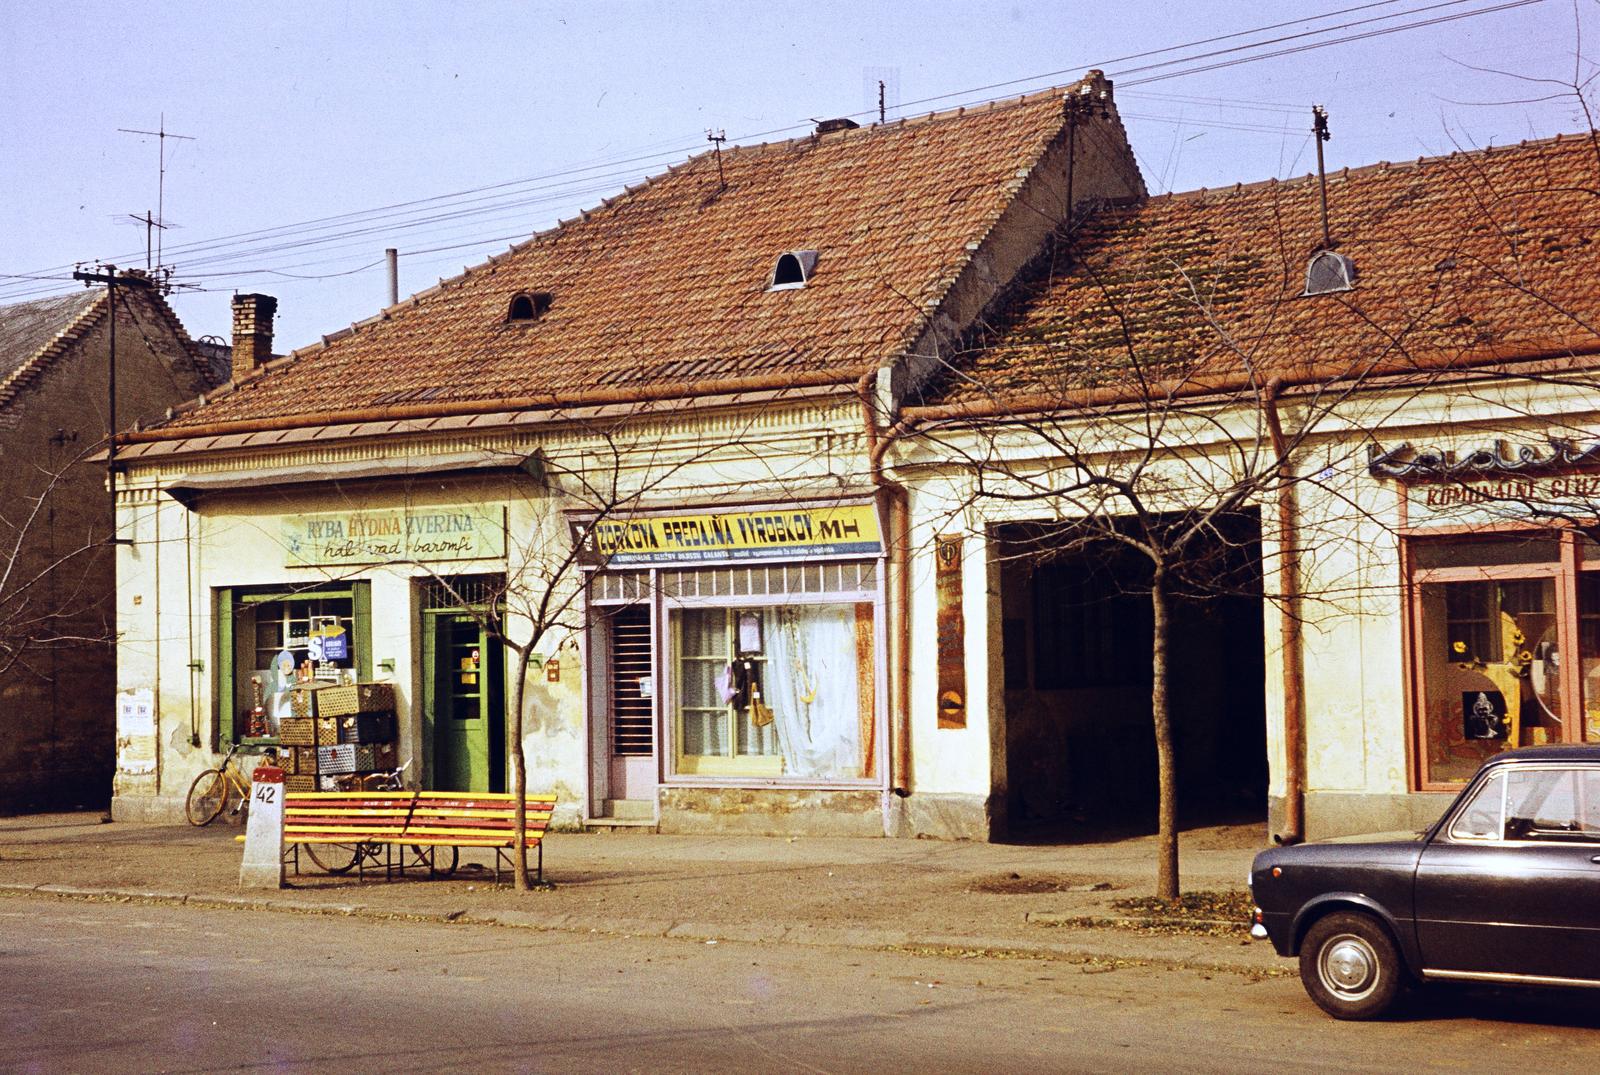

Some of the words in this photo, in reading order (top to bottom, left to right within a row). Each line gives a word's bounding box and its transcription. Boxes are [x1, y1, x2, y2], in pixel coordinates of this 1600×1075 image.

[308, 520, 344, 538] RYBA
[349, 516, 401, 537] HYDINA
[663, 515, 735, 547] PREDAJŇA
[820, 518, 860, 539] MH
[414, 536, 473, 557] baromfi
[256, 785, 276, 804] 42
